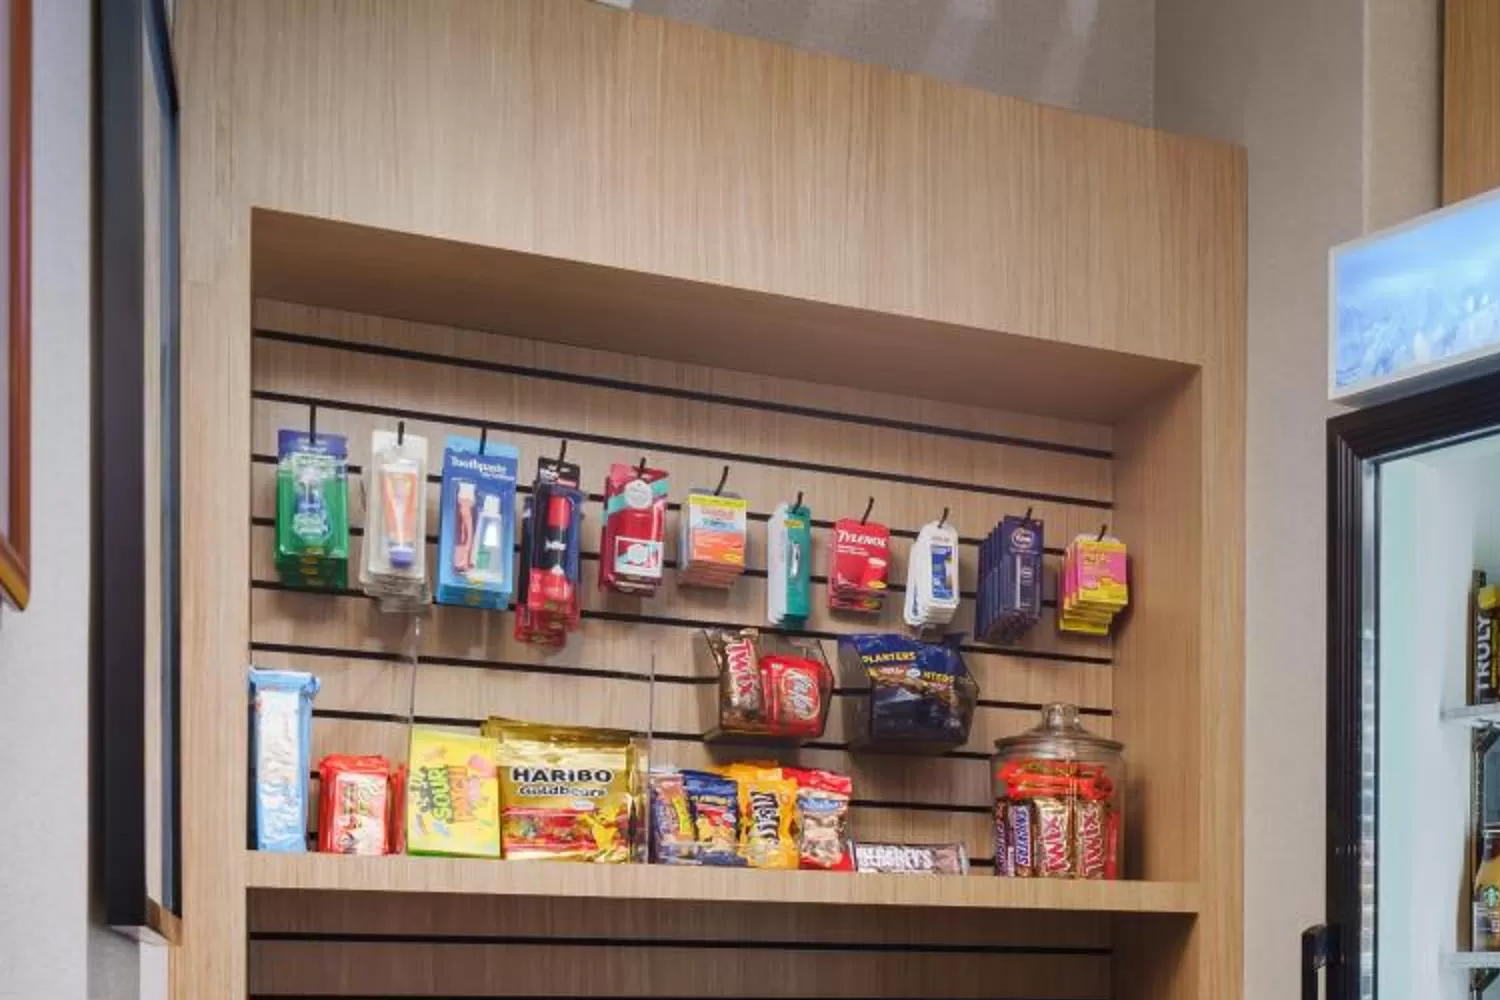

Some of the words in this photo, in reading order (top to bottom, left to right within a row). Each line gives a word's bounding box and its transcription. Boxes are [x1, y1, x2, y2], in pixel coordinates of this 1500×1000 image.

[837, 529, 886, 547] TYLENOL
[862, 650, 917, 664] PLANTERS
[512, 766, 614, 784] HARIBO
